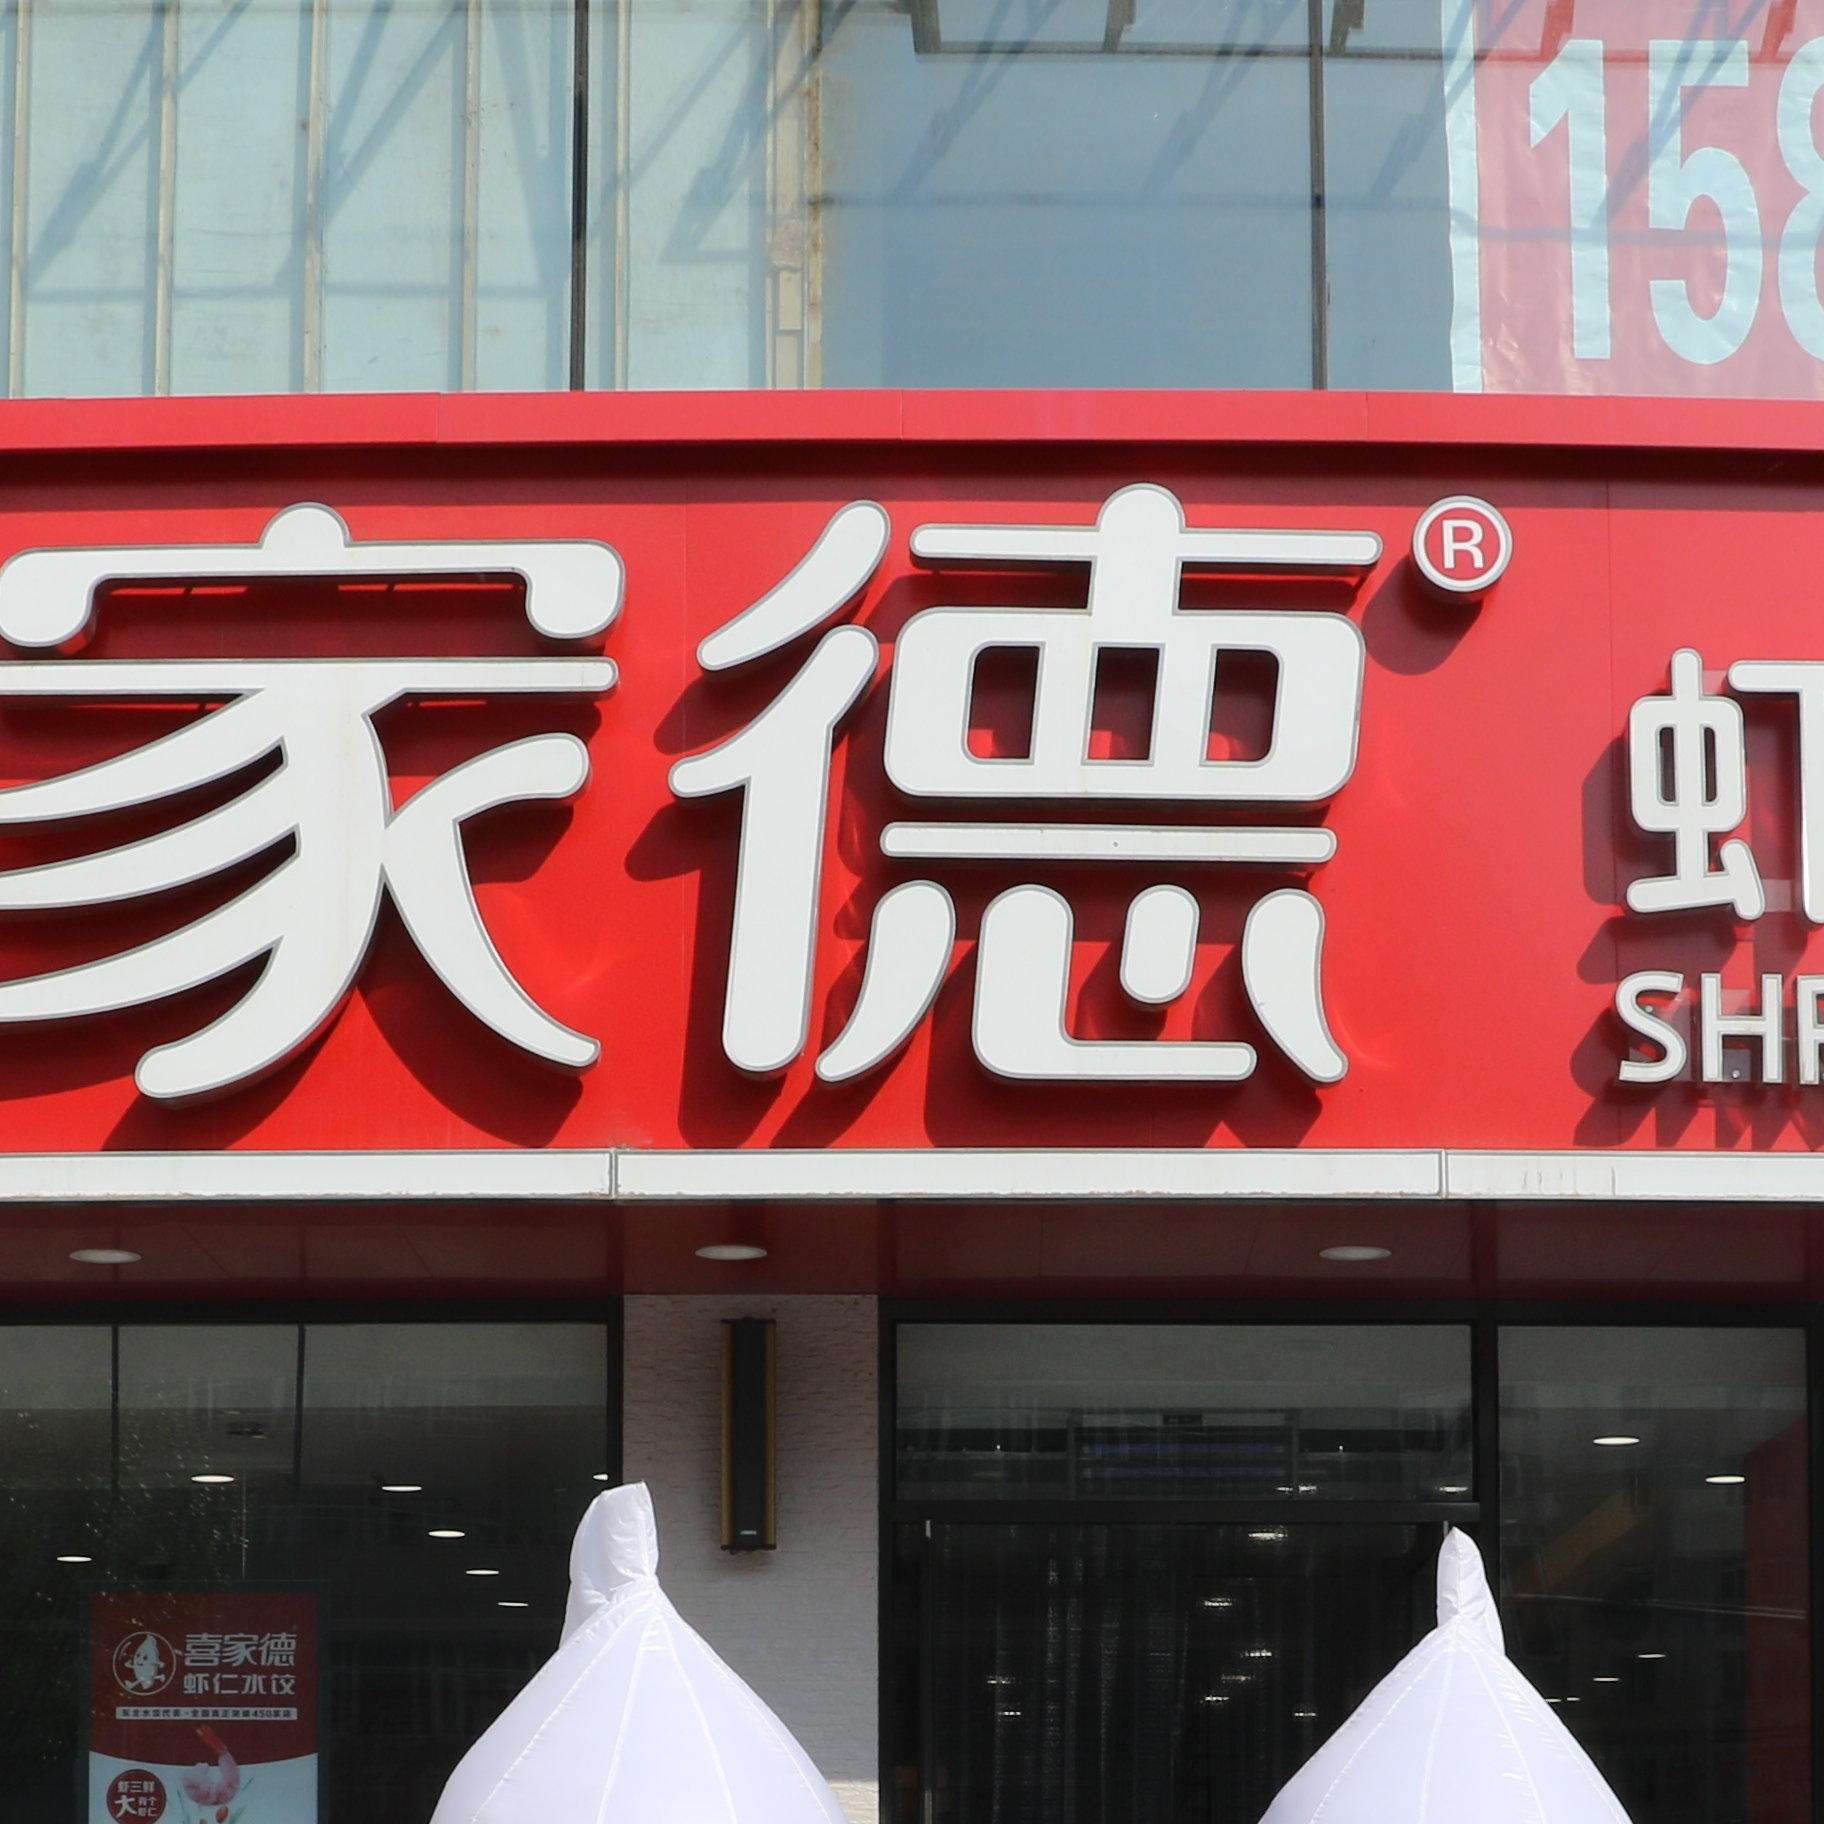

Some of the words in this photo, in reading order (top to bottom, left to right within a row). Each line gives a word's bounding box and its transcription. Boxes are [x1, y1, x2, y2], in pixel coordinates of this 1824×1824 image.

[183, 1632, 298, 1667] 喜家德
[182, 1673, 296, 1695] 虾仁水饺
